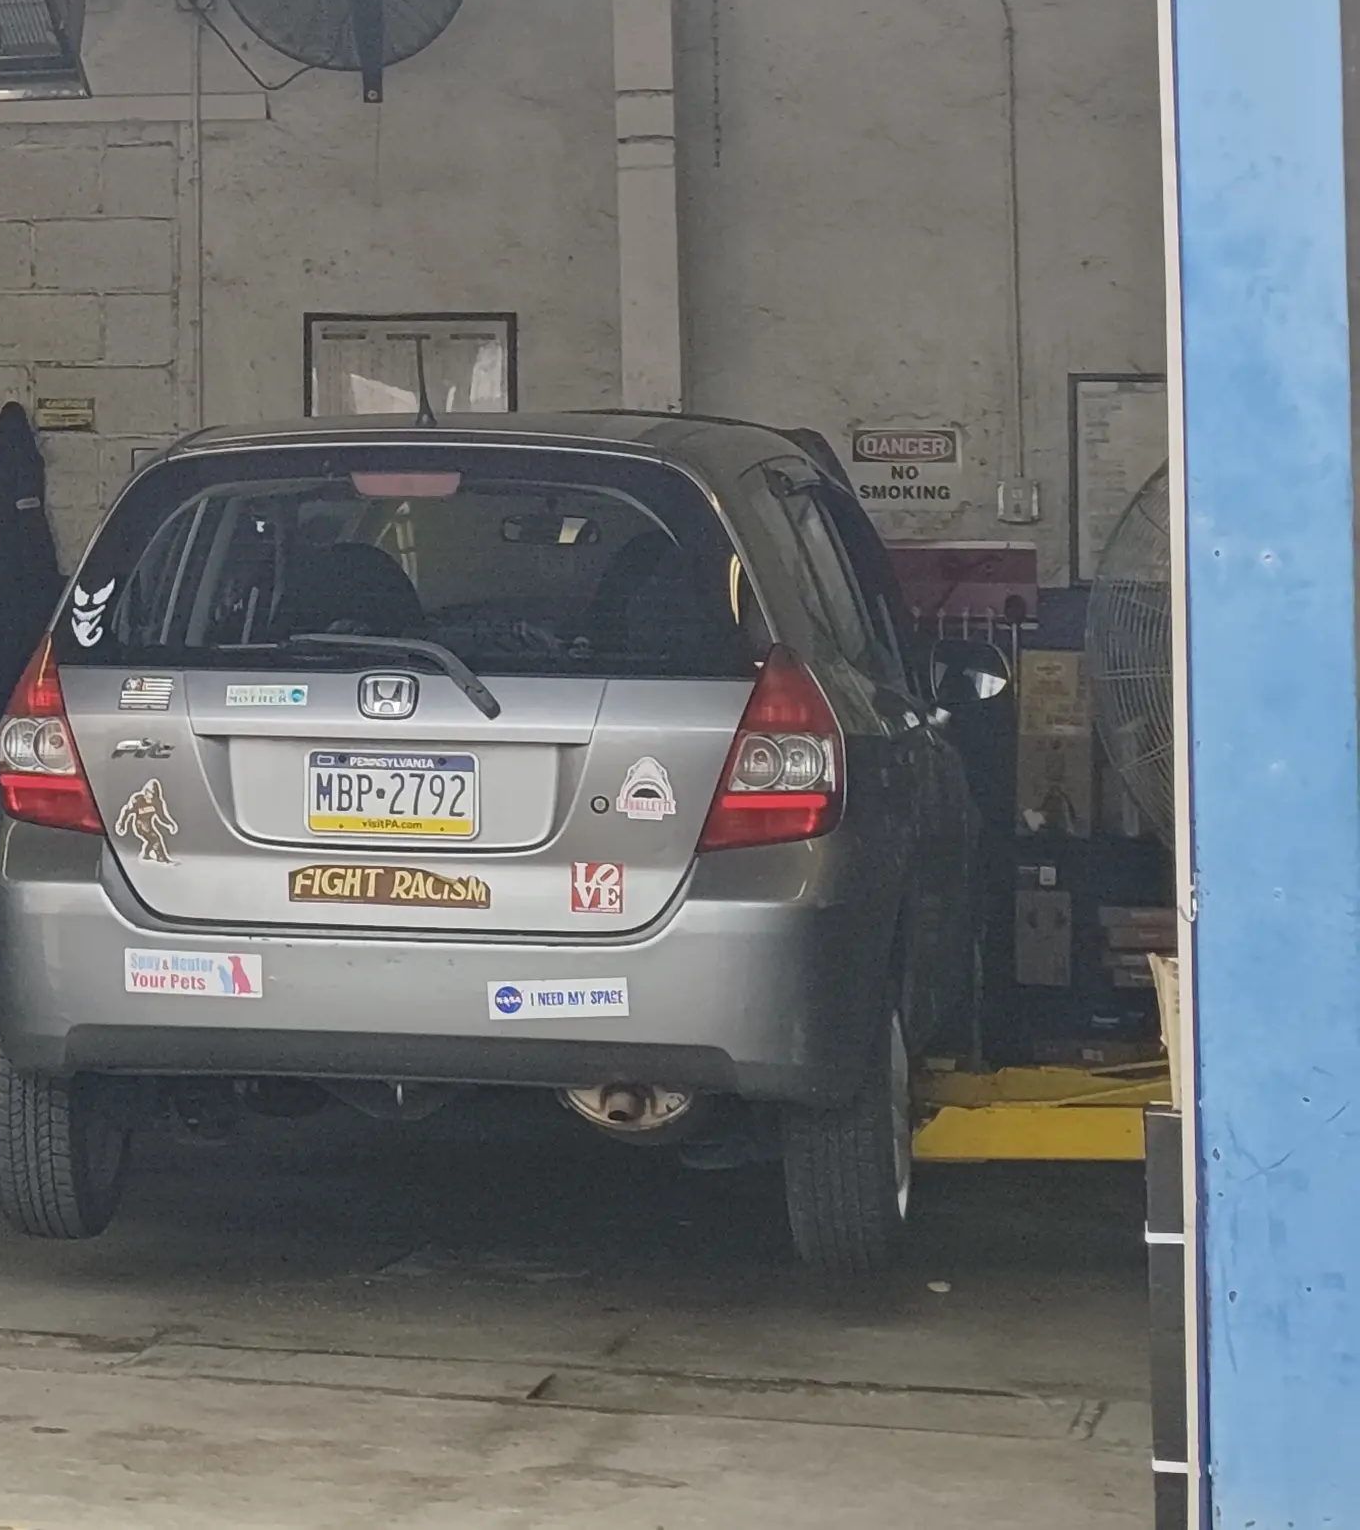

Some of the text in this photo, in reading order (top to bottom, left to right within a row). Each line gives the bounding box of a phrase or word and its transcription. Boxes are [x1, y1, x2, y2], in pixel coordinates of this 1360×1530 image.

[863, 437, 946, 455] DANGER
[891, 465, 920, 480] NO
[859, 484, 951, 500] SMOKING
[361, 819, 423, 830] visitPA.com
[293, 867, 487, 902] FIGHT RACISM
[171, 955, 214, 972] Neuter
[131, 971, 206, 990] Your Pets
[537, 991, 564, 1006] NEED
[568, 990, 586, 1005] MY
[590, 989, 624, 1004] SPACE
